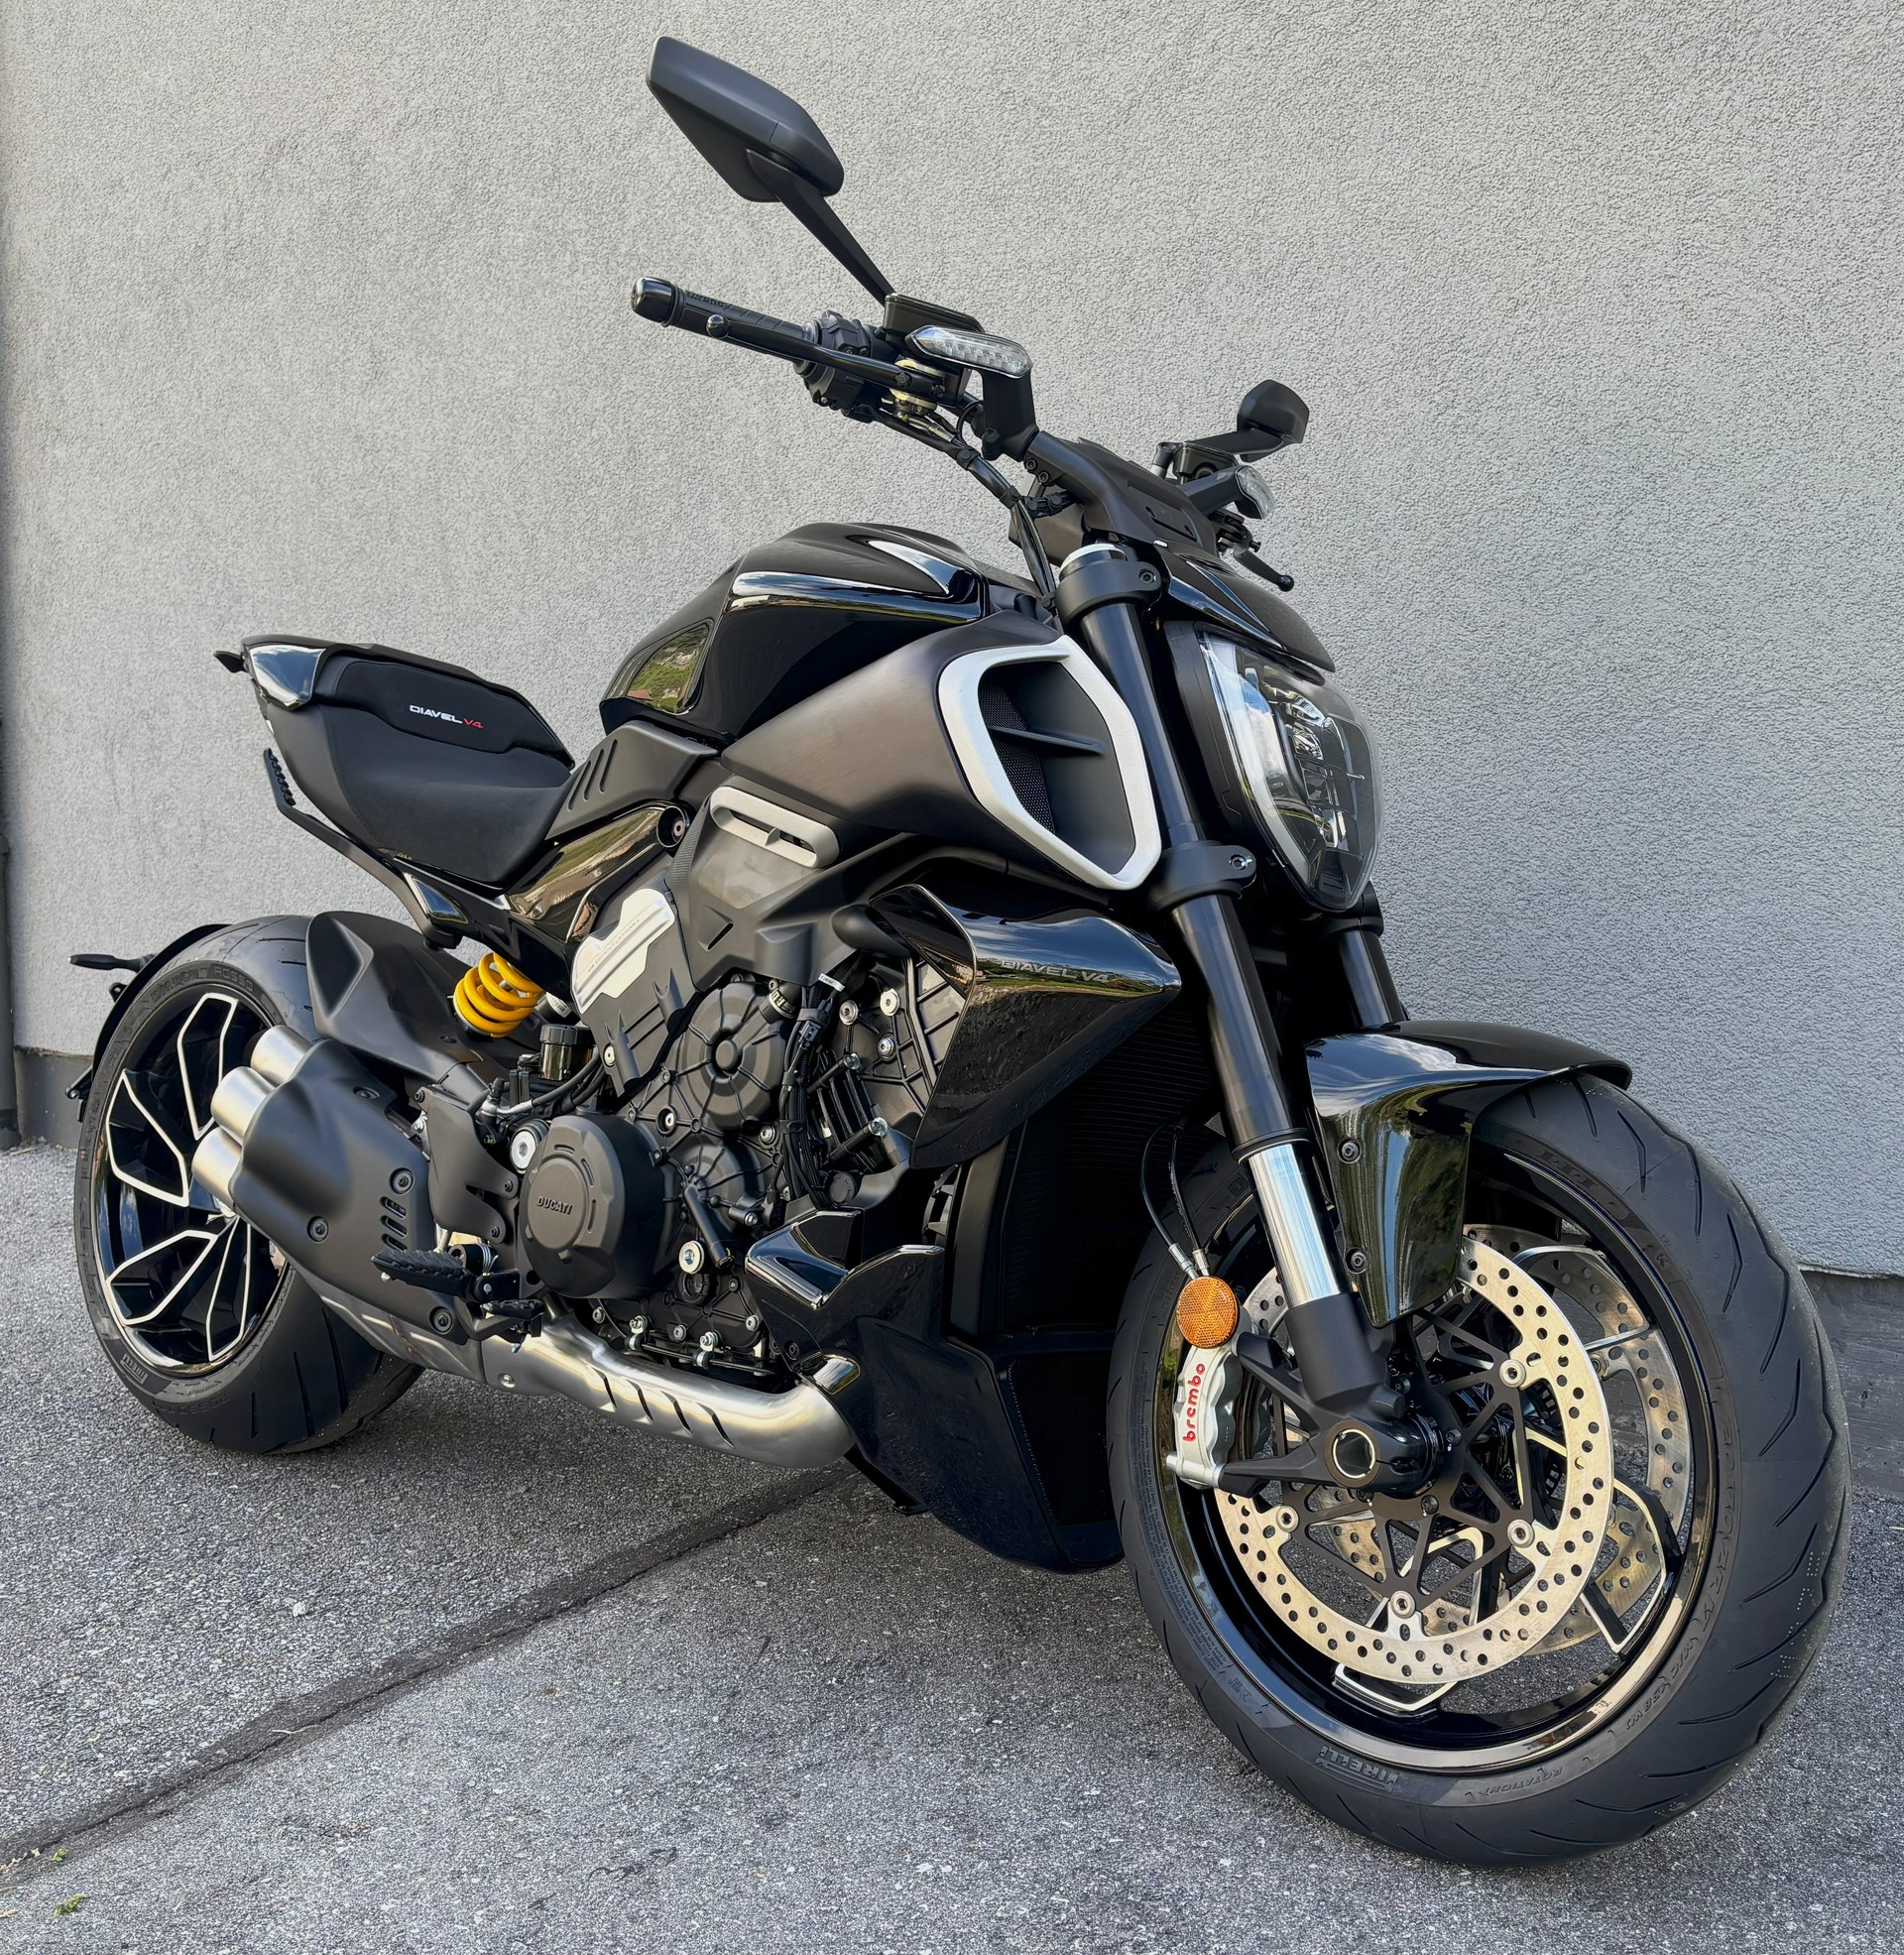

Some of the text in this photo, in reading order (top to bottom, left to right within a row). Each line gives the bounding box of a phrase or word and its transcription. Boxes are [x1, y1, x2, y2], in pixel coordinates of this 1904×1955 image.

[409, 704, 484, 729] DIAVEL V4
[213, 965, 255, 992] ROSSO
[1000, 959, 1113, 984] DIAVEL V4
[536, 1196, 573, 1215] DUCATI
[119, 1353, 149, 1386] PIRELLI
[1183, 1363, 1206, 1442] brembo
[1315, 1746, 1400, 1793] PIRELLI
[1488, 1767, 1563, 1795] ROTATION
